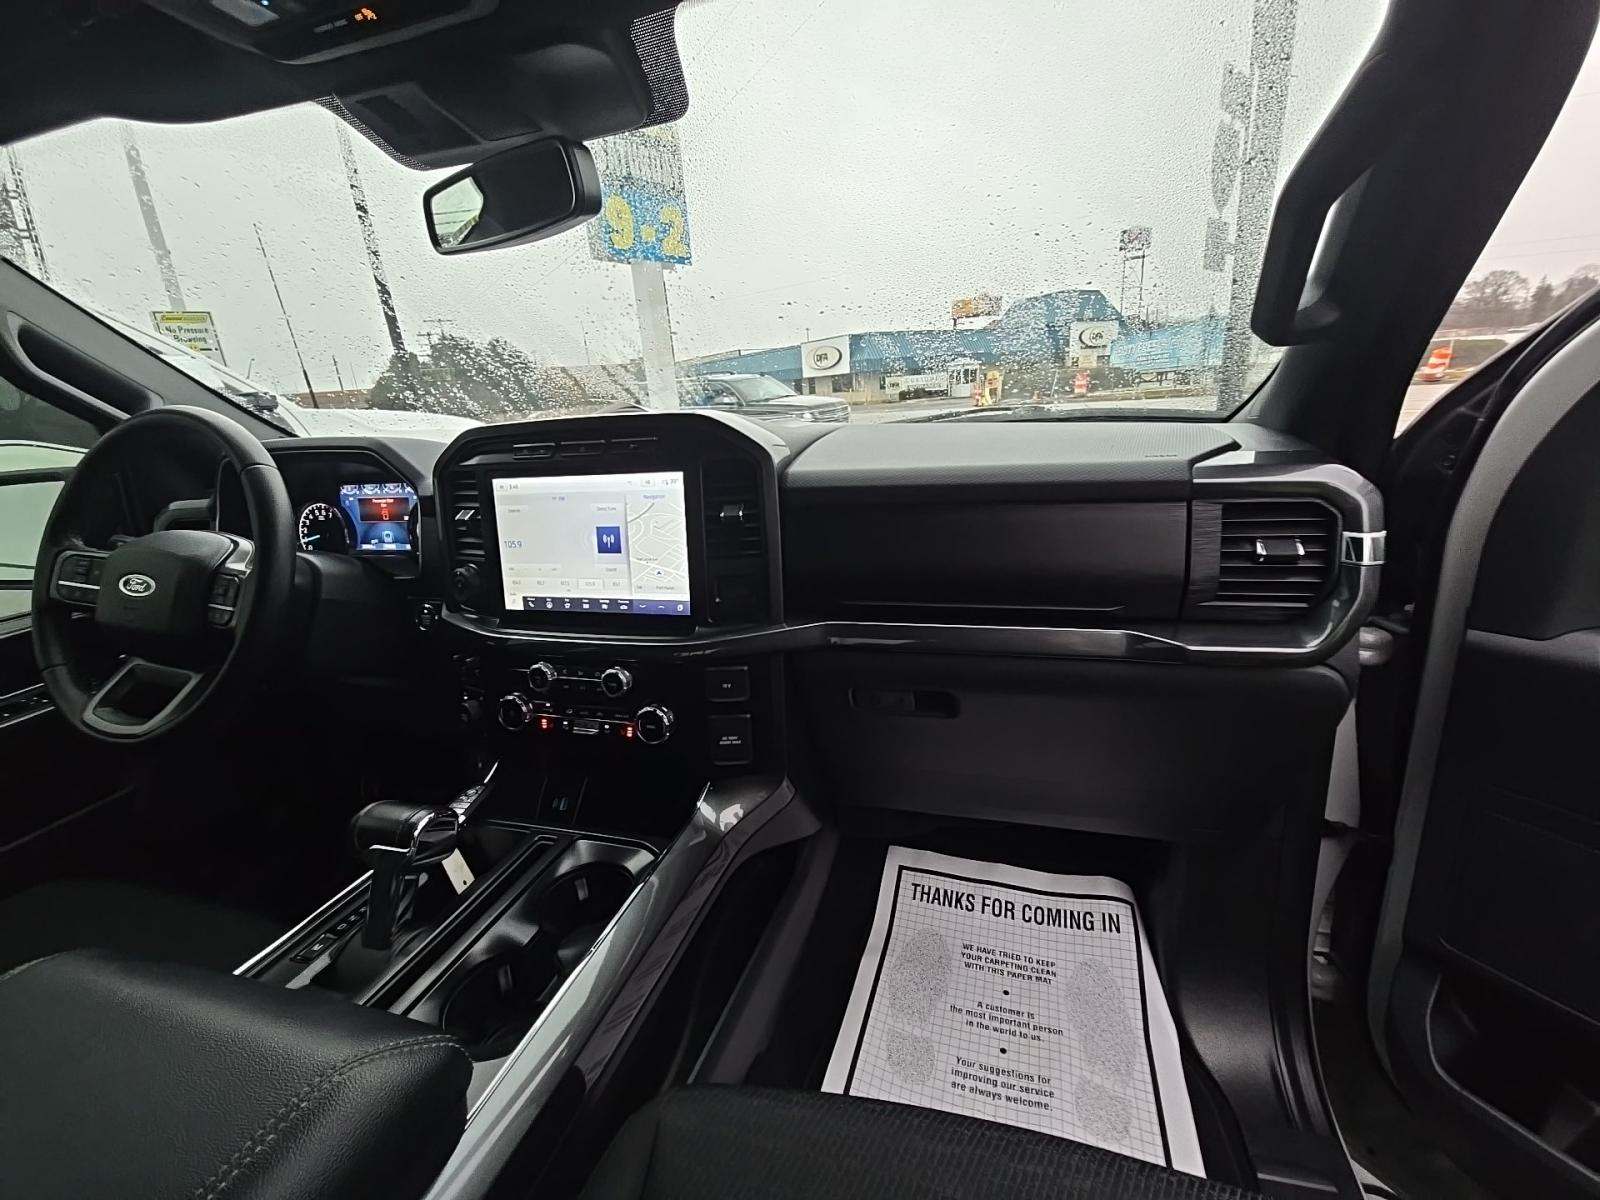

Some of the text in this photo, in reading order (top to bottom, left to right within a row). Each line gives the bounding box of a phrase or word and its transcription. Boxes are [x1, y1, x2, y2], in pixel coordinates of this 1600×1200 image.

[911, 882, 1121, 934] THANKS FOR COMING IN
[961, 951, 1057, 978] YOUR CARPETING CLEAN
[962, 943, 1056, 968] WE HAVE TRIED TO KEEP
[964, 961, 1052, 985] WITH THIS PAPER MAT
[950, 1004, 1064, 1037] the most important person
[976, 1001, 1035, 1020] A customer is
[966, 1019, 974, 1027] in
[976, 1021, 990, 1031] the
[993, 1026, 1017, 1038] world
[1019, 1031, 1028, 1040] to
[951, 1067, 1055, 1099] improving our service
[956, 1056, 1052, 1085] Your suggestions for
[951, 1080, 1054, 1112] are always welcome.
